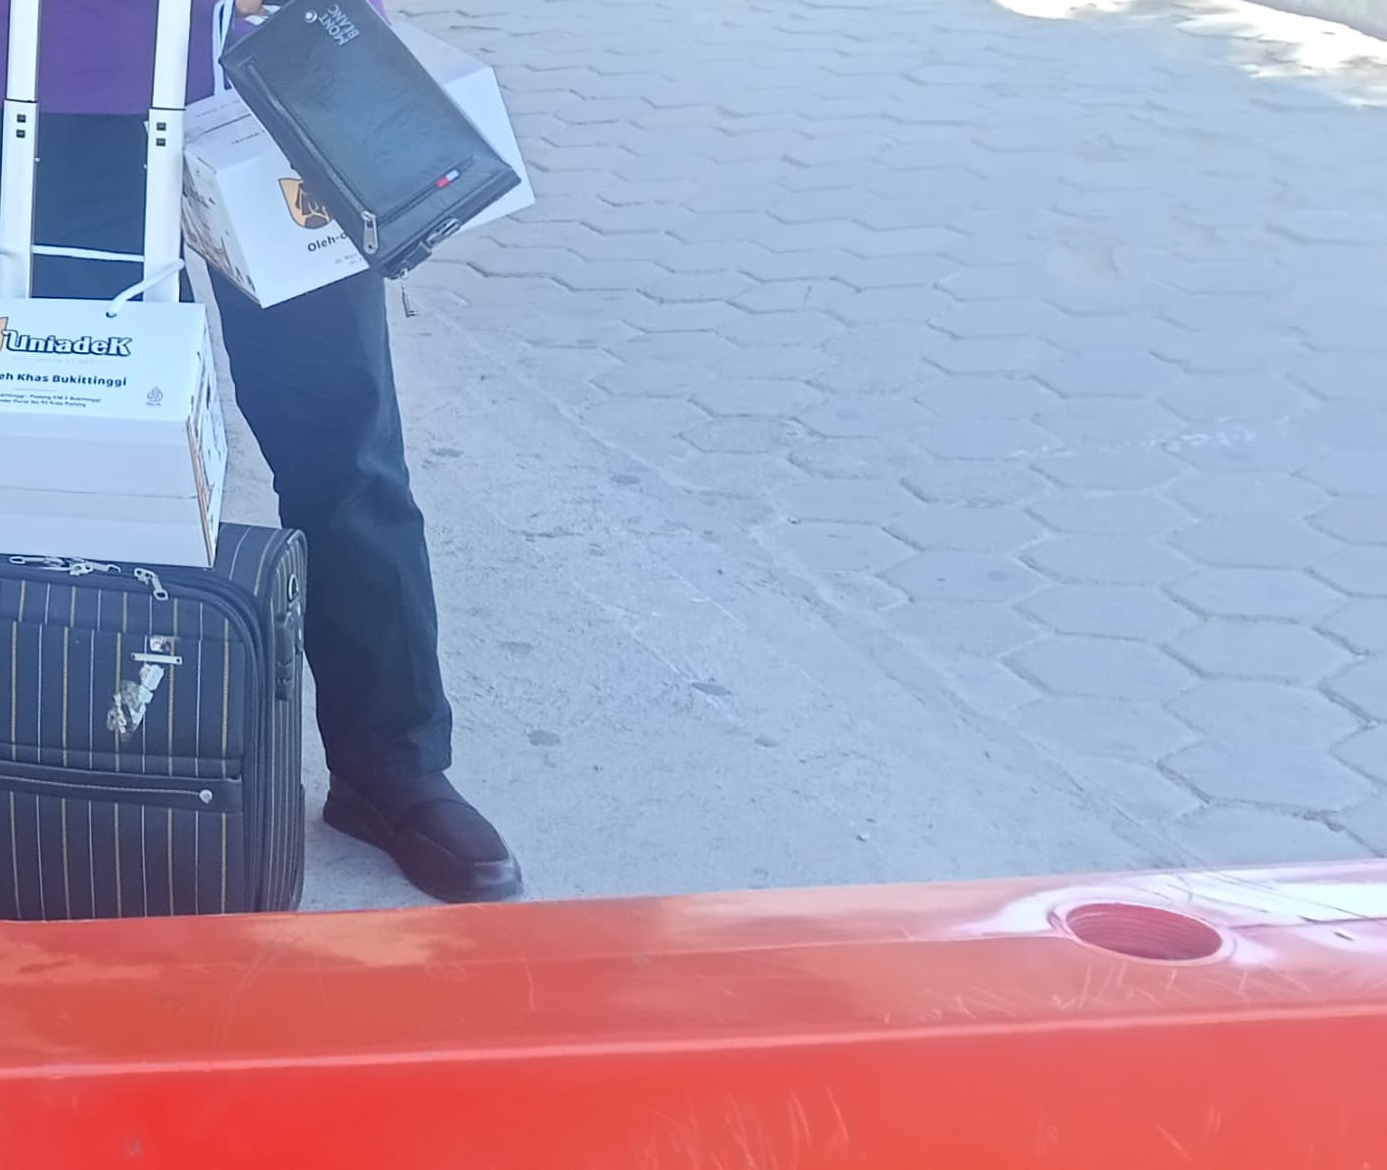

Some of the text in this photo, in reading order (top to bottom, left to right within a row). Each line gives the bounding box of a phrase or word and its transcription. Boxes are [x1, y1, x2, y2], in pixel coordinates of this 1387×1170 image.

[318, 13, 349, 46] MONT
[328, 4, 360, 39] BLANC
[307, 232, 349, 252] Oleh-o
[17, 373, 49, 382] Khas
[52, 375, 127, 387] Bukittinggi
